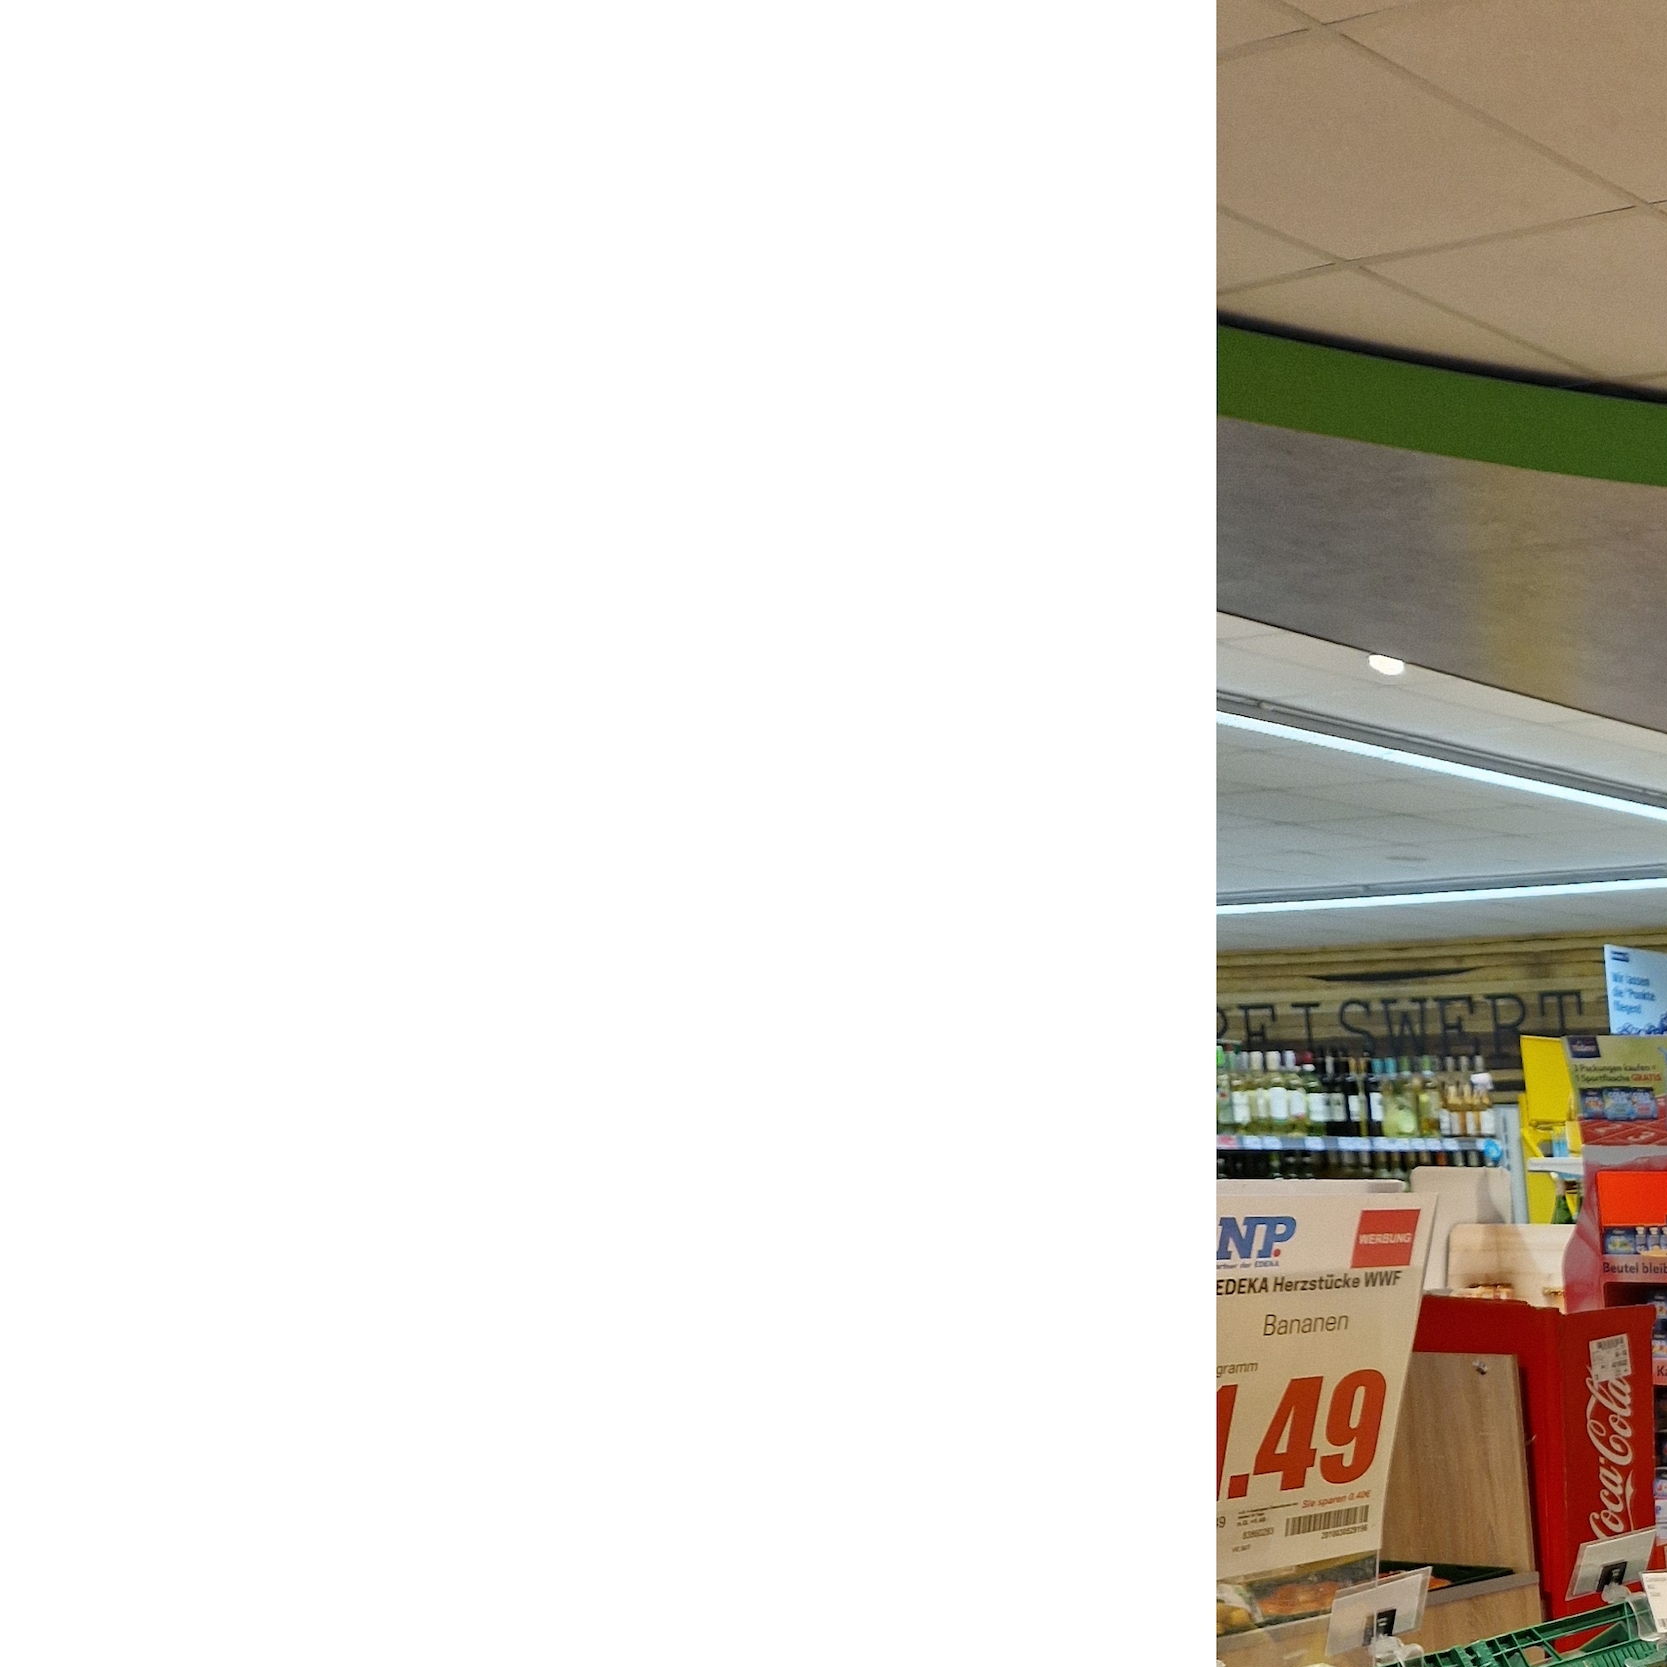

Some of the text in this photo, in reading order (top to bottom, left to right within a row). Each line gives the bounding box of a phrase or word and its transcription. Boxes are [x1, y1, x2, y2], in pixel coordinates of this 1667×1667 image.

[1630, 1073, 1662, 1082] GRATIS
[1359, 1233, 1412, 1245] WERBUNG
[1254, 1260, 1279, 1268] EDEKA
[1602, 1261, 1640, 1274] Beutel
[1217, 1270, 1403, 1296] EDEKA Herzstücke WWF
[1263, 1313, 1349, 1337] Bananen
[1217, 1368, 1387, 1502] 1.49
[1301, 1499, 1316, 1509] Sie
[1317, 1495, 1347, 1508] sparen
